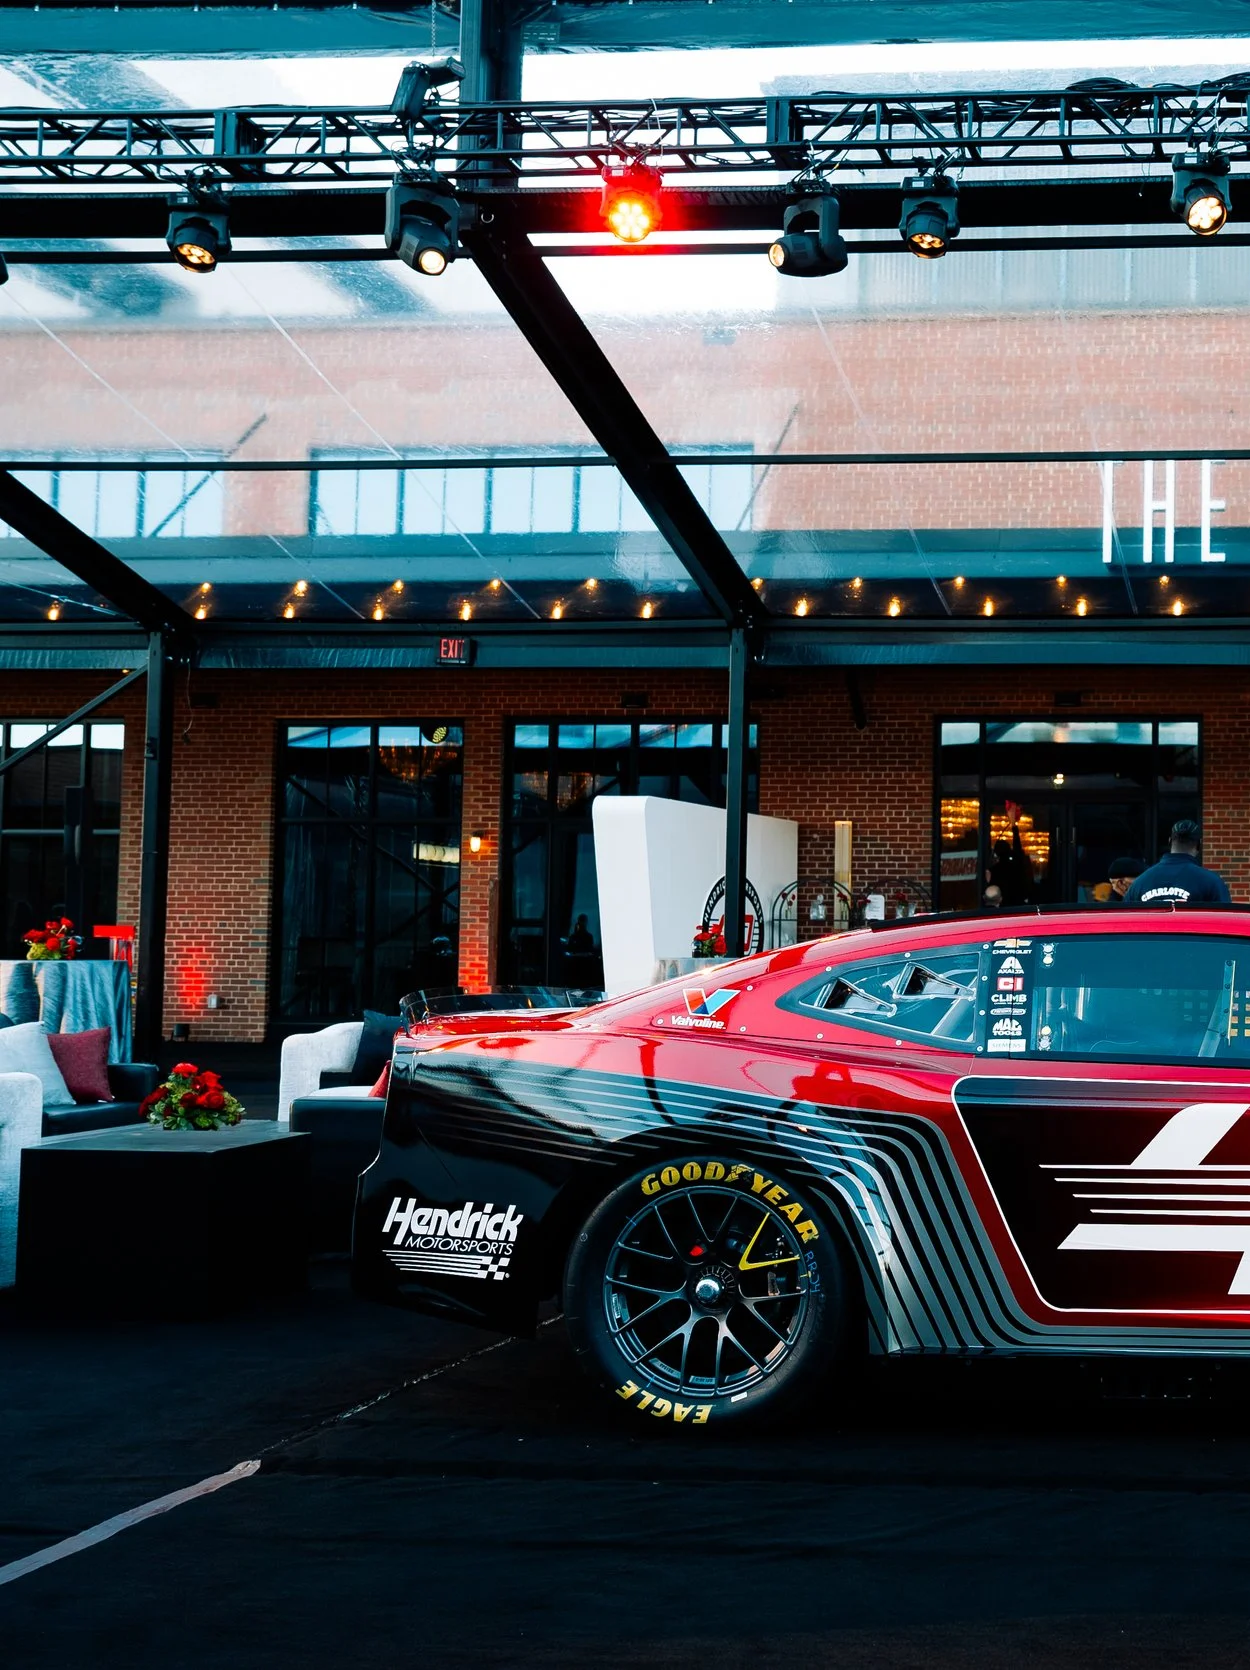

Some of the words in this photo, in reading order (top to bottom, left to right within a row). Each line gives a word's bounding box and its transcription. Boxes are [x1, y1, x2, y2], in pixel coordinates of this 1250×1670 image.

[1097, 458, 1227, 563] THE
[440, 638, 465, 659] EXIT
[1141, 886, 1191, 902] CHARLOTTE
[991, 993, 1027, 1003] CLIMB
[671, 1015, 725, 1030] Valvoline
[992, 1017, 1022, 1031] MAC
[641, 1160, 820, 1244] GOODYEAR
[382, 1196, 524, 1246] Hendrick
[404, 1235, 515, 1256] MOTORSPORTS
[615, 1379, 716, 1424] EAGLE
